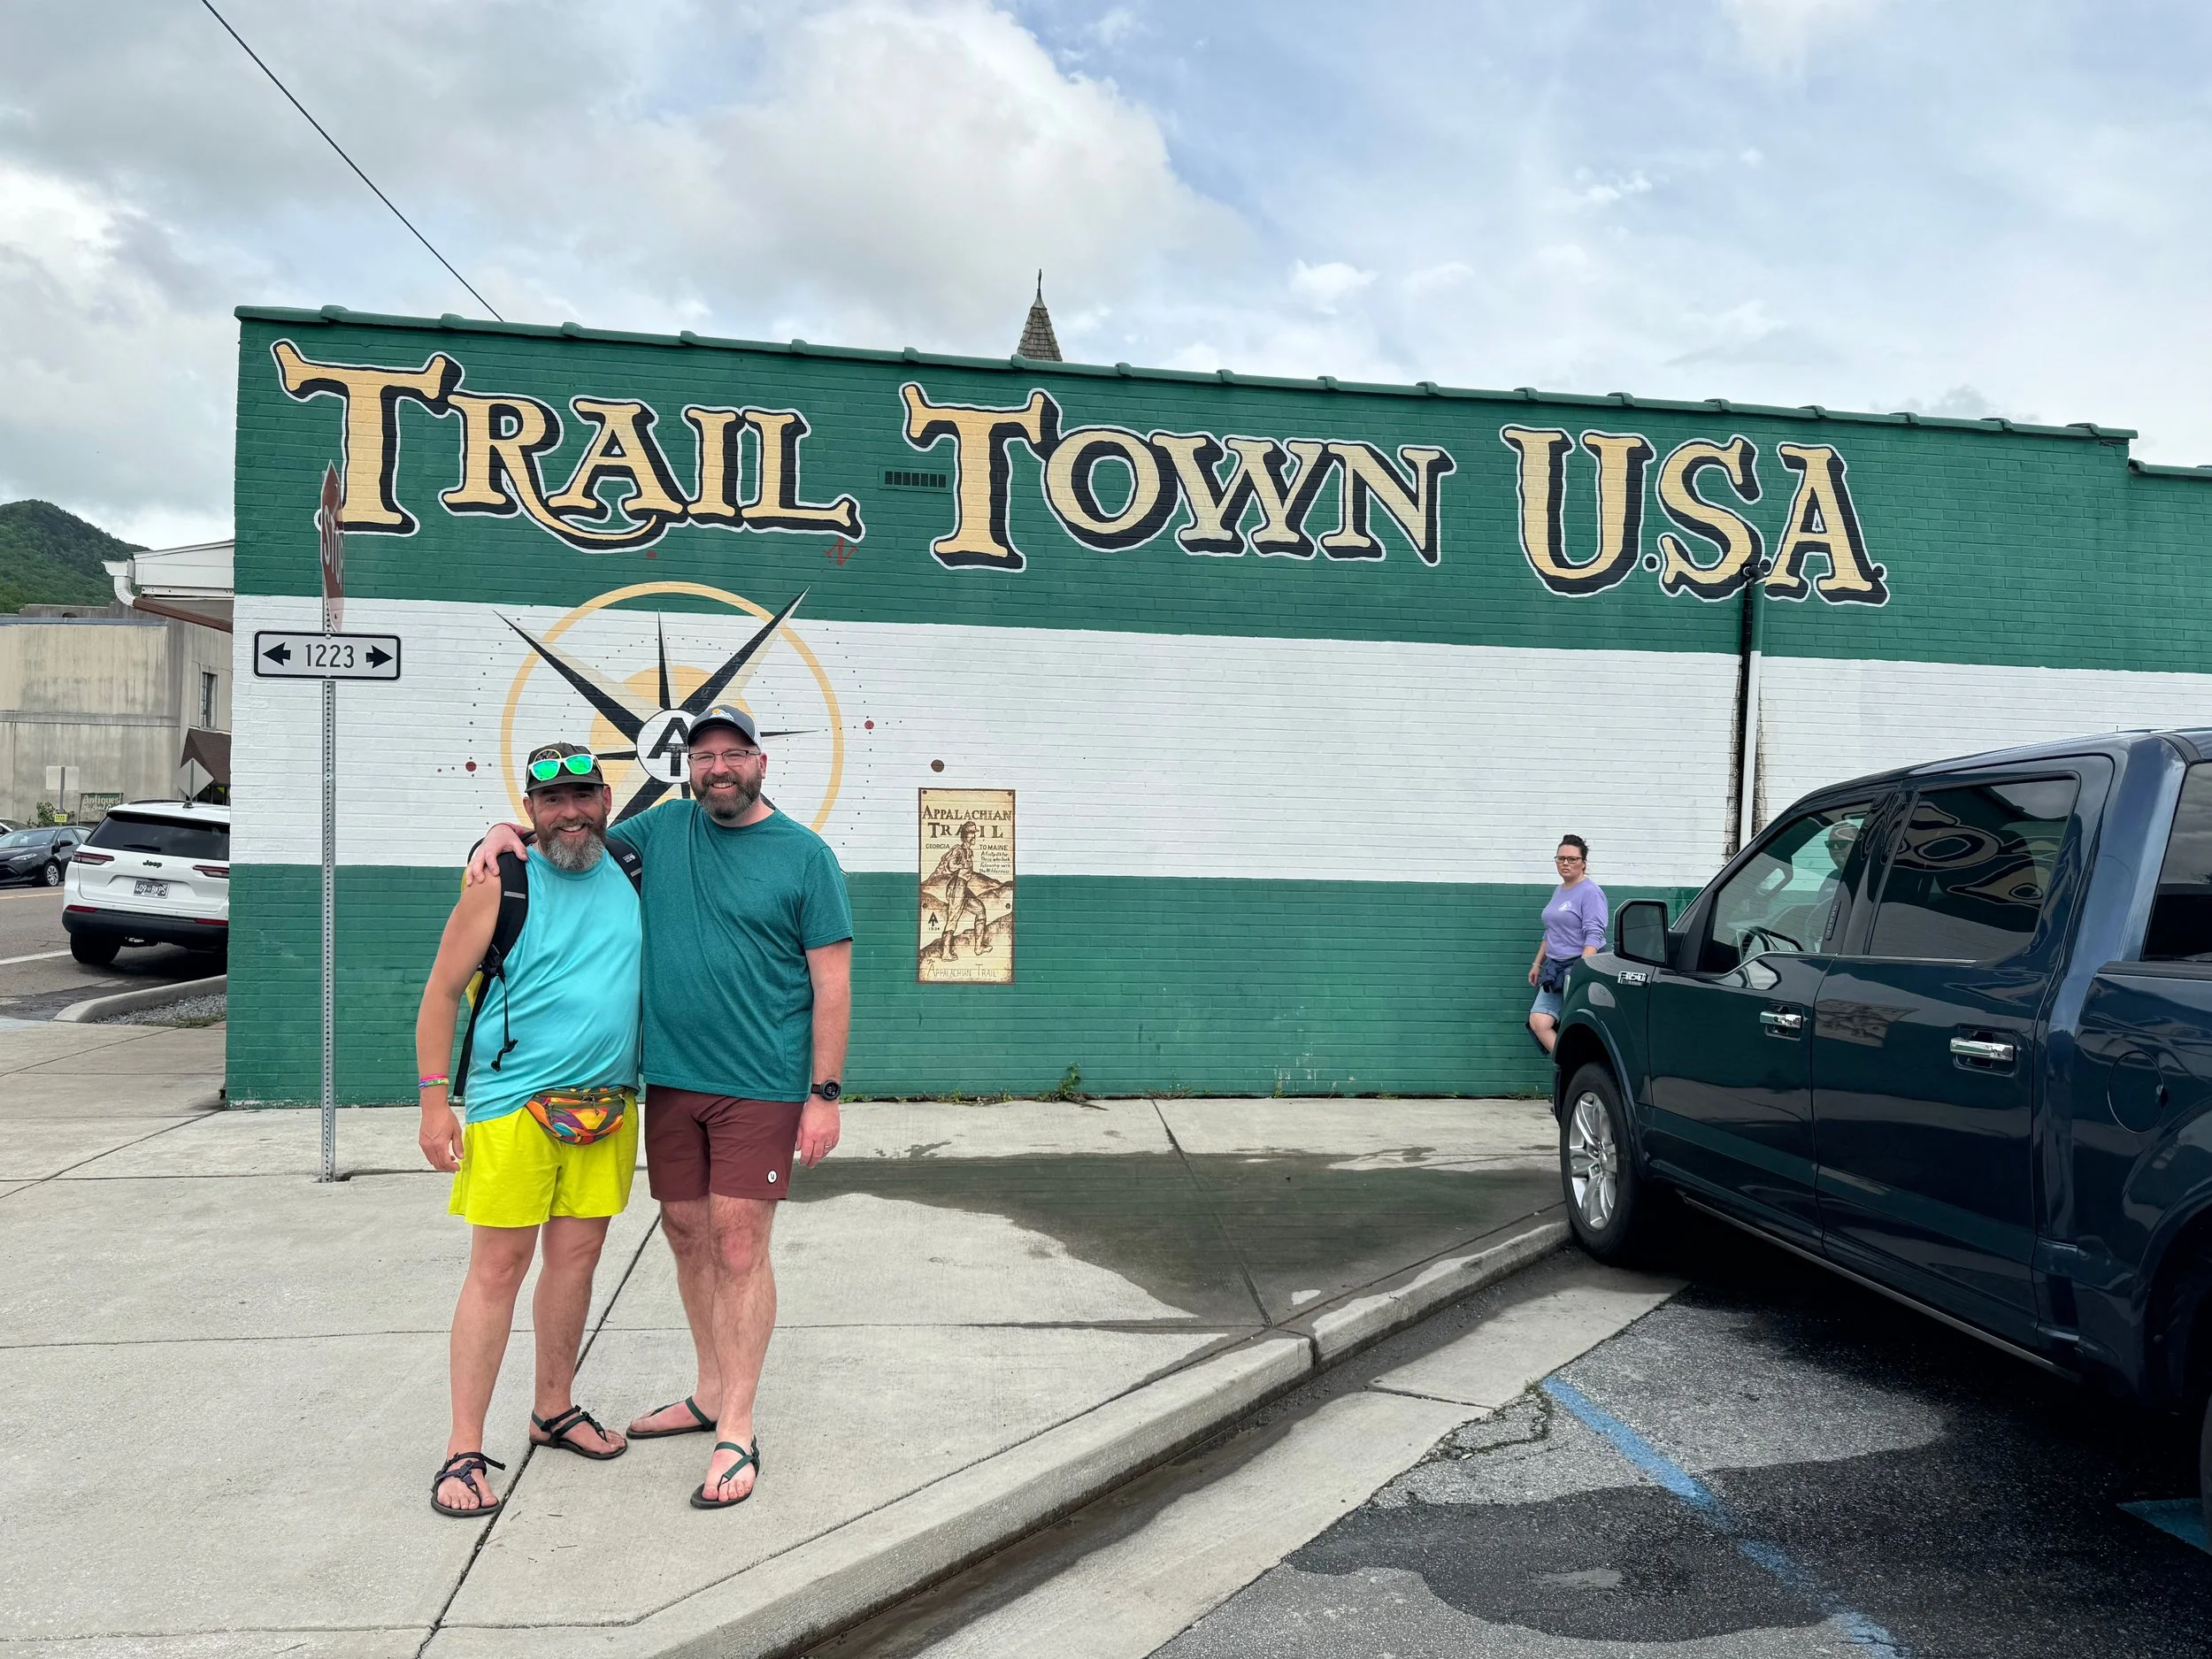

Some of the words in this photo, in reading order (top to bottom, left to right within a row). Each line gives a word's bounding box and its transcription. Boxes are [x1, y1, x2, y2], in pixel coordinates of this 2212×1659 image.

[271, 338, 865, 553] TRAIL
[898, 381, 1457, 573] TOWN
[322, 504, 346, 592] STOP
[305, 643, 355, 669] 1223
[82, 794, 119, 805] Antiques
[922, 804, 1012, 821] APPALACHIAN
[135, 884, 147, 893] 409
[927, 963, 972, 978] APPALACHIAN
[975, 964, 997, 978] TRAIL
